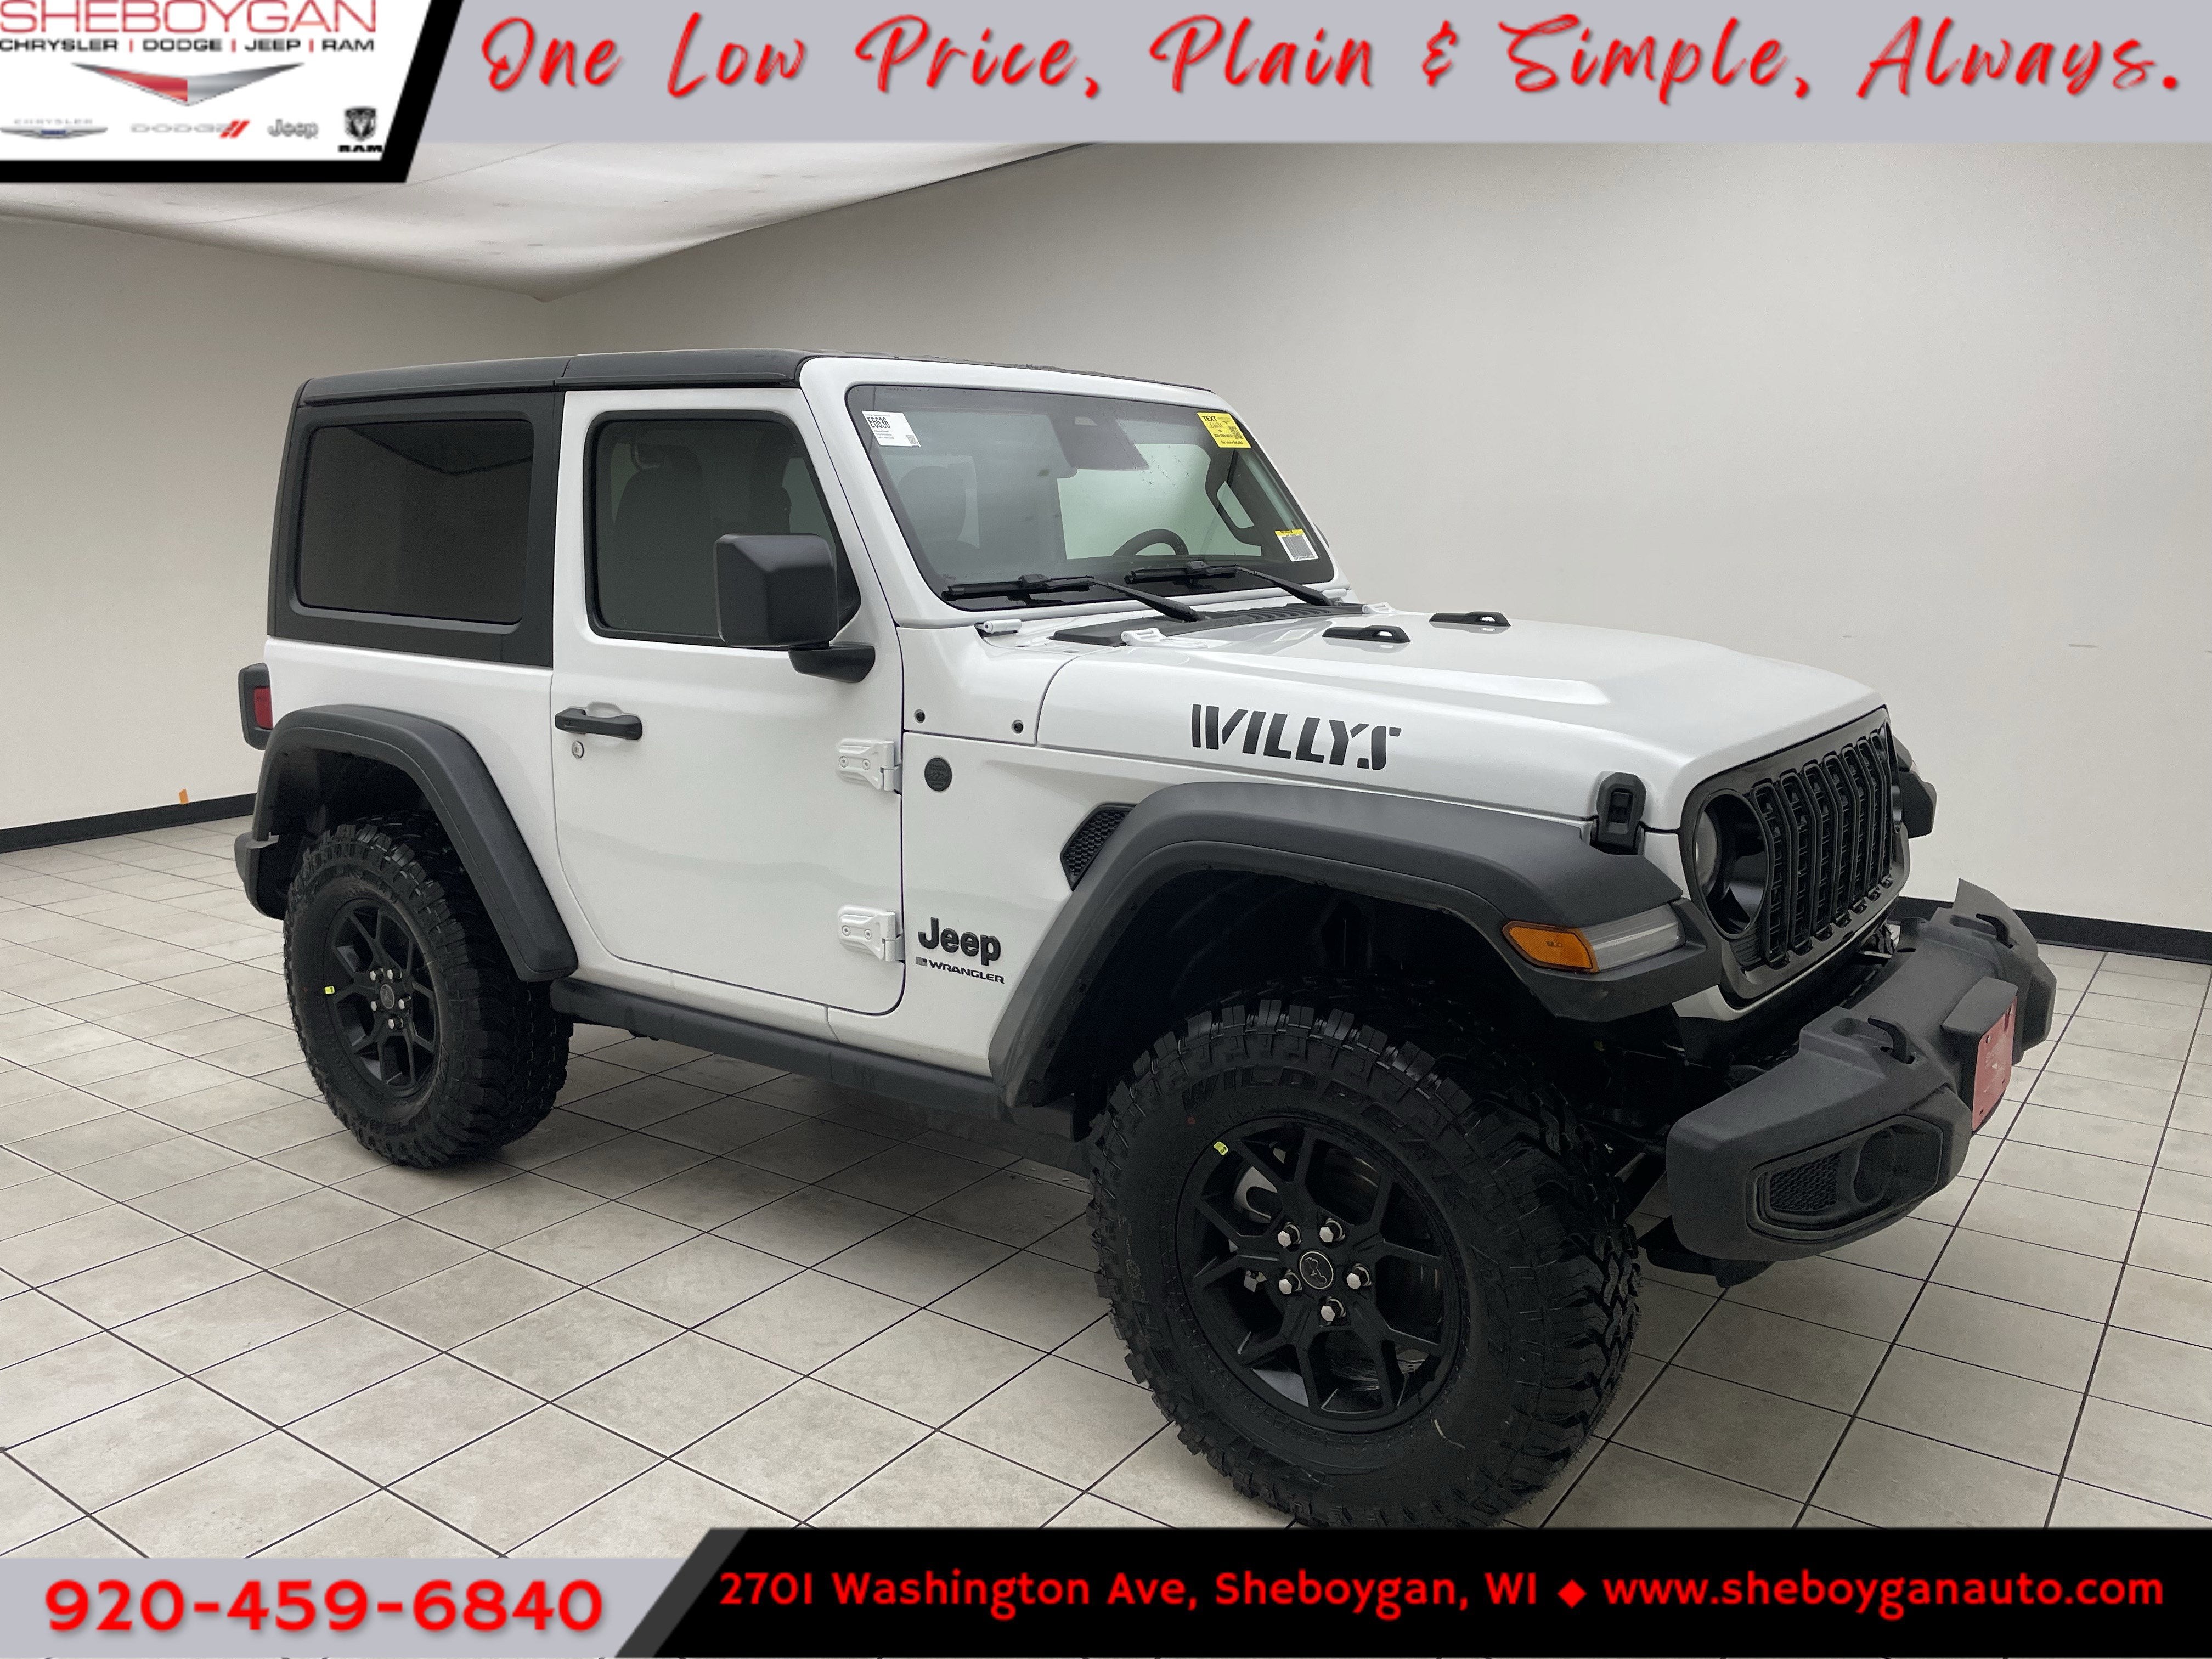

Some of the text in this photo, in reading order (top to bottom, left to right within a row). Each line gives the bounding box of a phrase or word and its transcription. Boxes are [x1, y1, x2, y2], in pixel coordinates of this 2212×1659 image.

[867, 417, 890, 428] E6636
[1192, 704, 1402, 770] WILLYS
[918, 917, 1001, 966] Jeep
[928, 959, 1005, 984] WRANGLER
